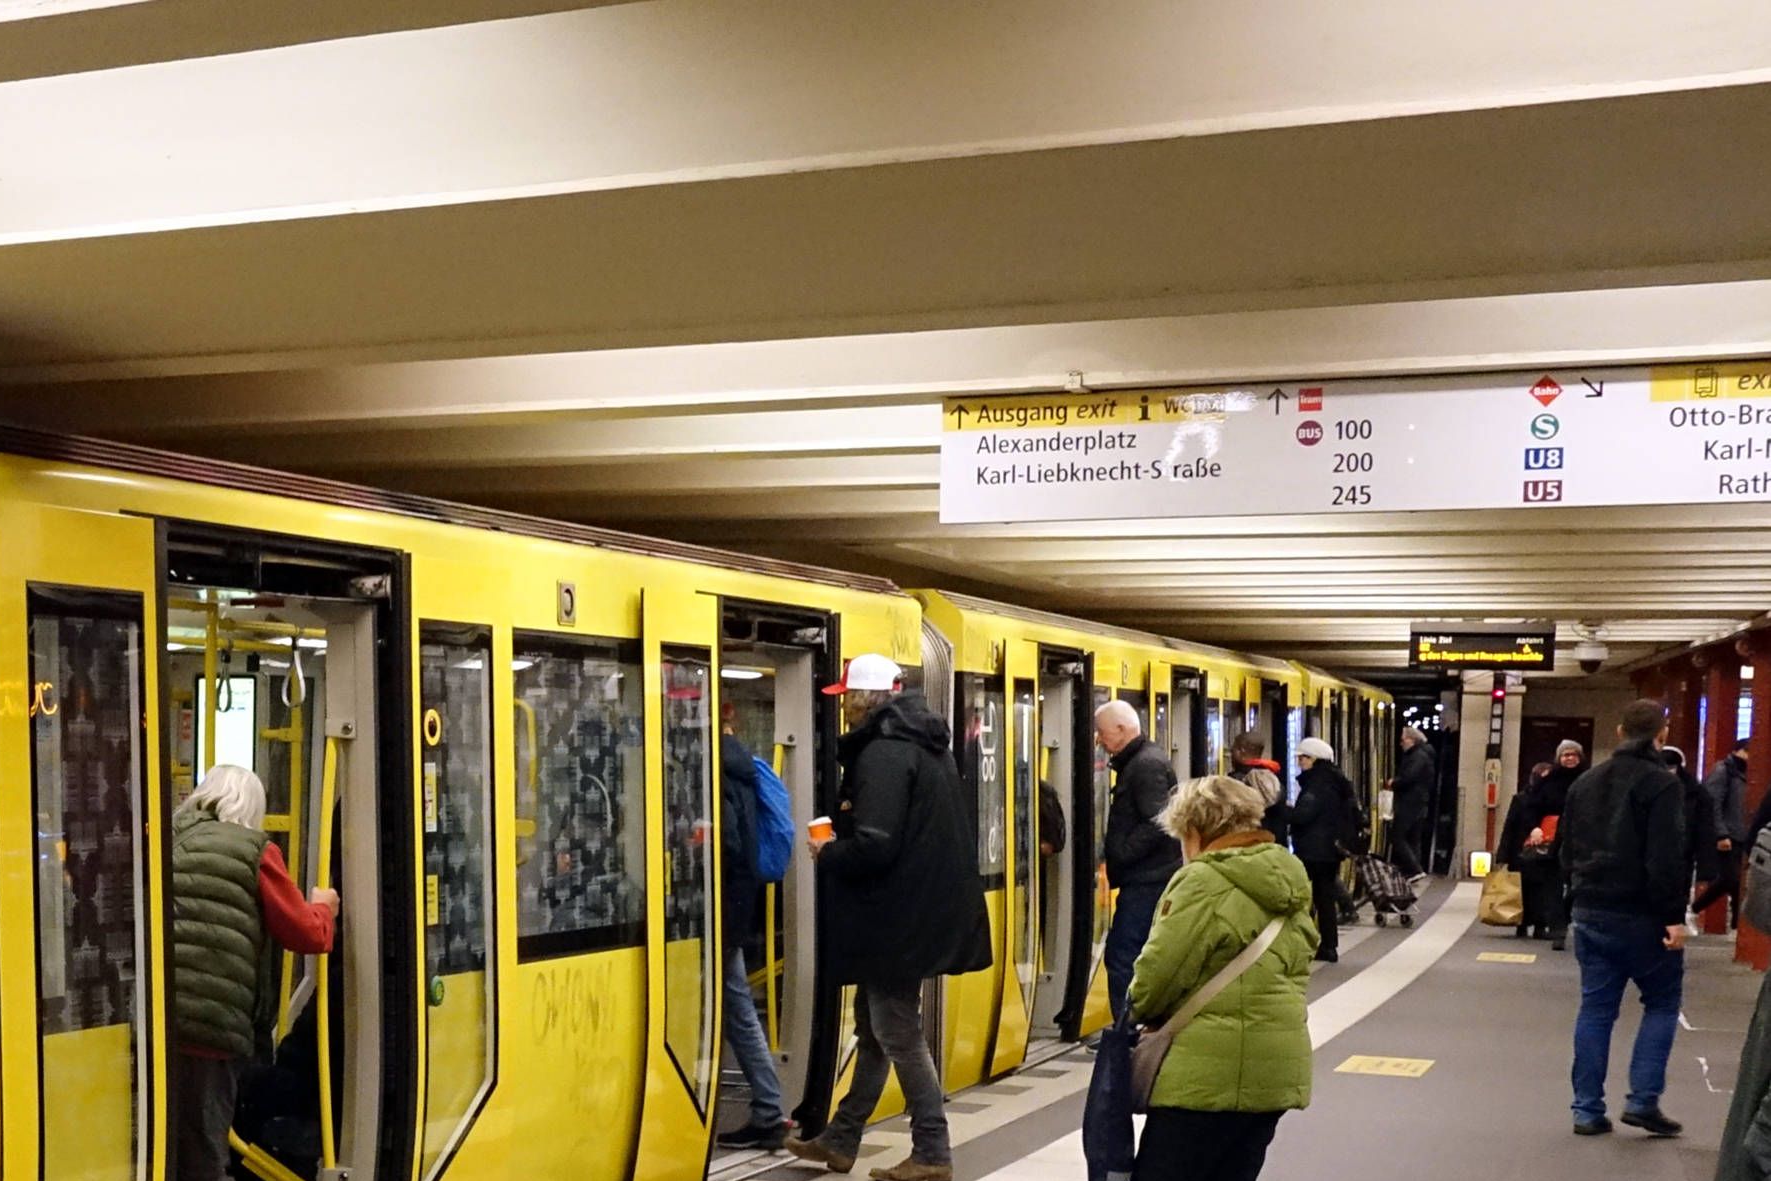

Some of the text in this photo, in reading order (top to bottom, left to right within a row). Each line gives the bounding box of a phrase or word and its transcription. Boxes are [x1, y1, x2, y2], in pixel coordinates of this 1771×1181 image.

[1532, 386, 1560, 397] Bahn
[977, 403, 1068, 427] Ausgang
[1076, 398, 1117, 420] exit
[1297, 427, 1323, 440] BUS
[1336, 419, 1373, 441] 100
[1532, 415, 1558, 439] S
[977, 431, 1137, 455] Alexanderplatz
[1703, 437, 1771, 461] Karl-
[1333, 452, 1373, 473] 200
[1528, 449, 1561, 468] U8
[977, 457, 1222, 485] Karl-Liebknecht-Sraße
[1332, 485, 1372, 506] 245
[1528, 482, 1559, 500] U5
